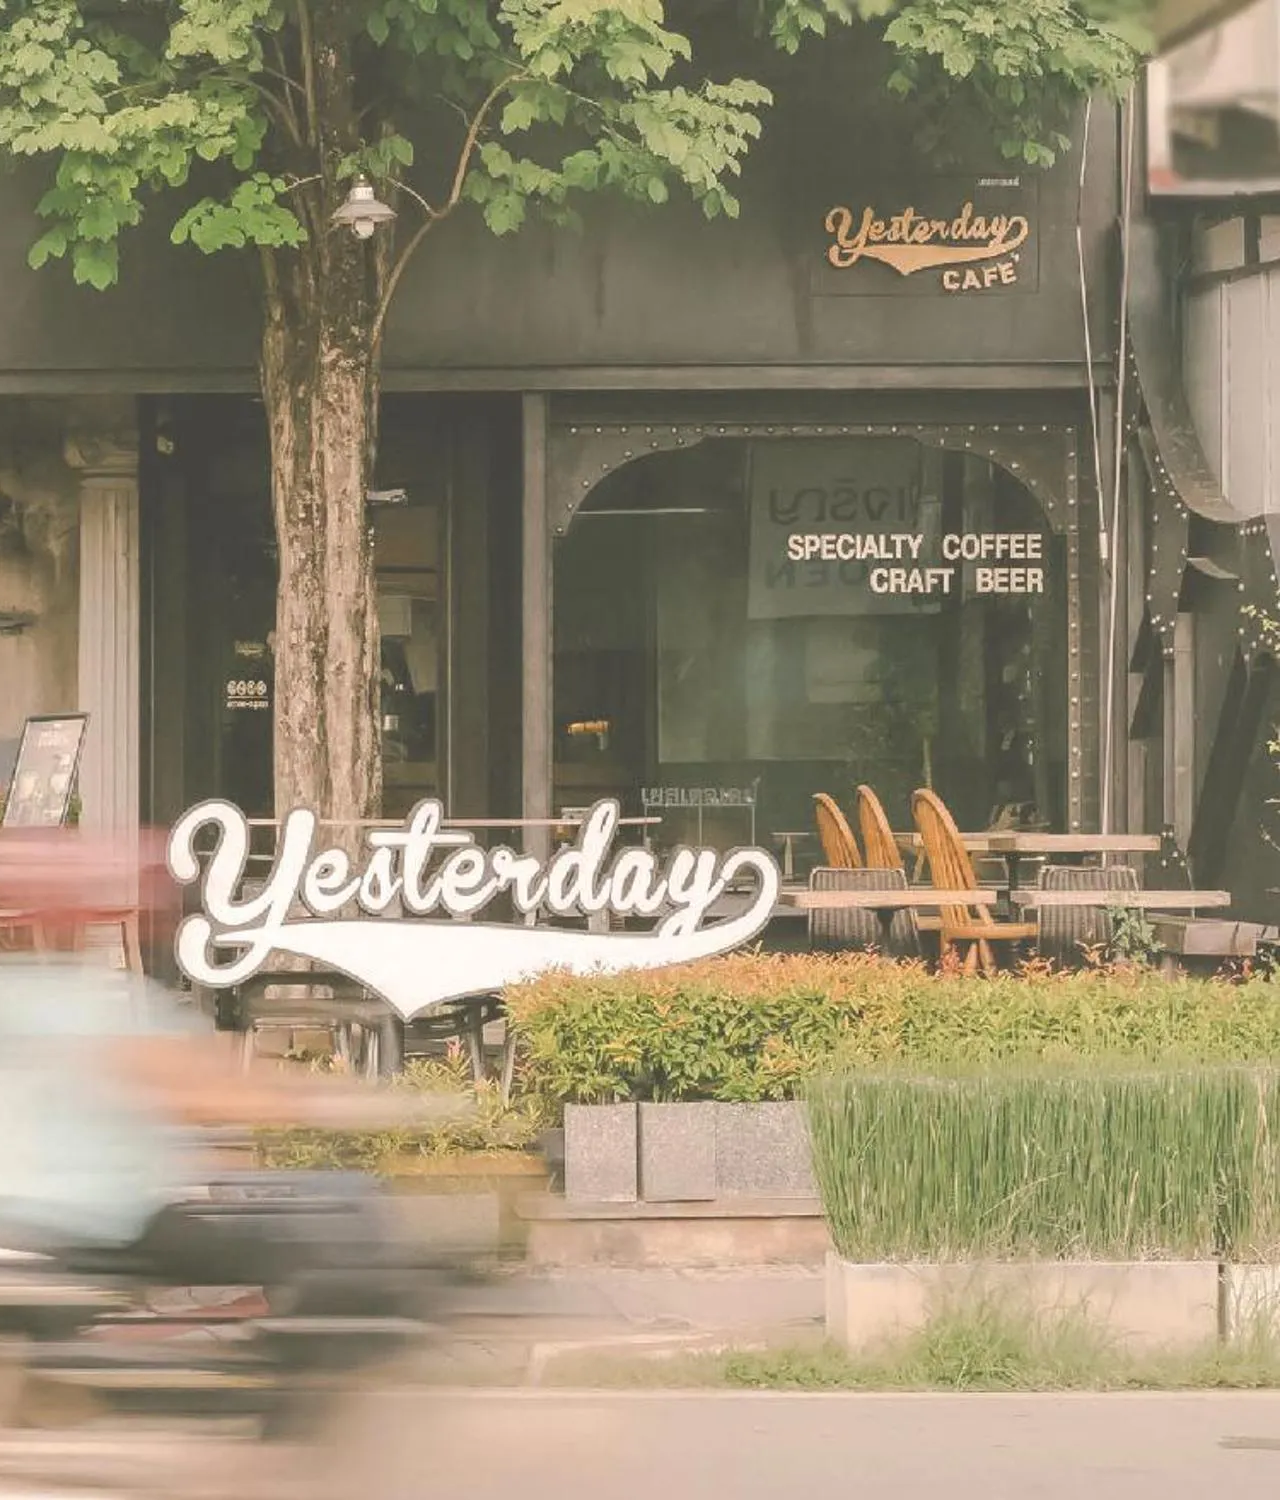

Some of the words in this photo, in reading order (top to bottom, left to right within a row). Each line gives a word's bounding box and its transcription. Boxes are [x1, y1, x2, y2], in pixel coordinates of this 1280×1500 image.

[825, 201, 1028, 268] Yesterday
[787, 534, 924, 560] SPECIALTY
[942, 534, 1042, 560] COFFEE
[869, 568, 954, 593] CRAFT
[976, 568, 1043, 593] BEER
[168, 798, 781, 988] Yesterday
